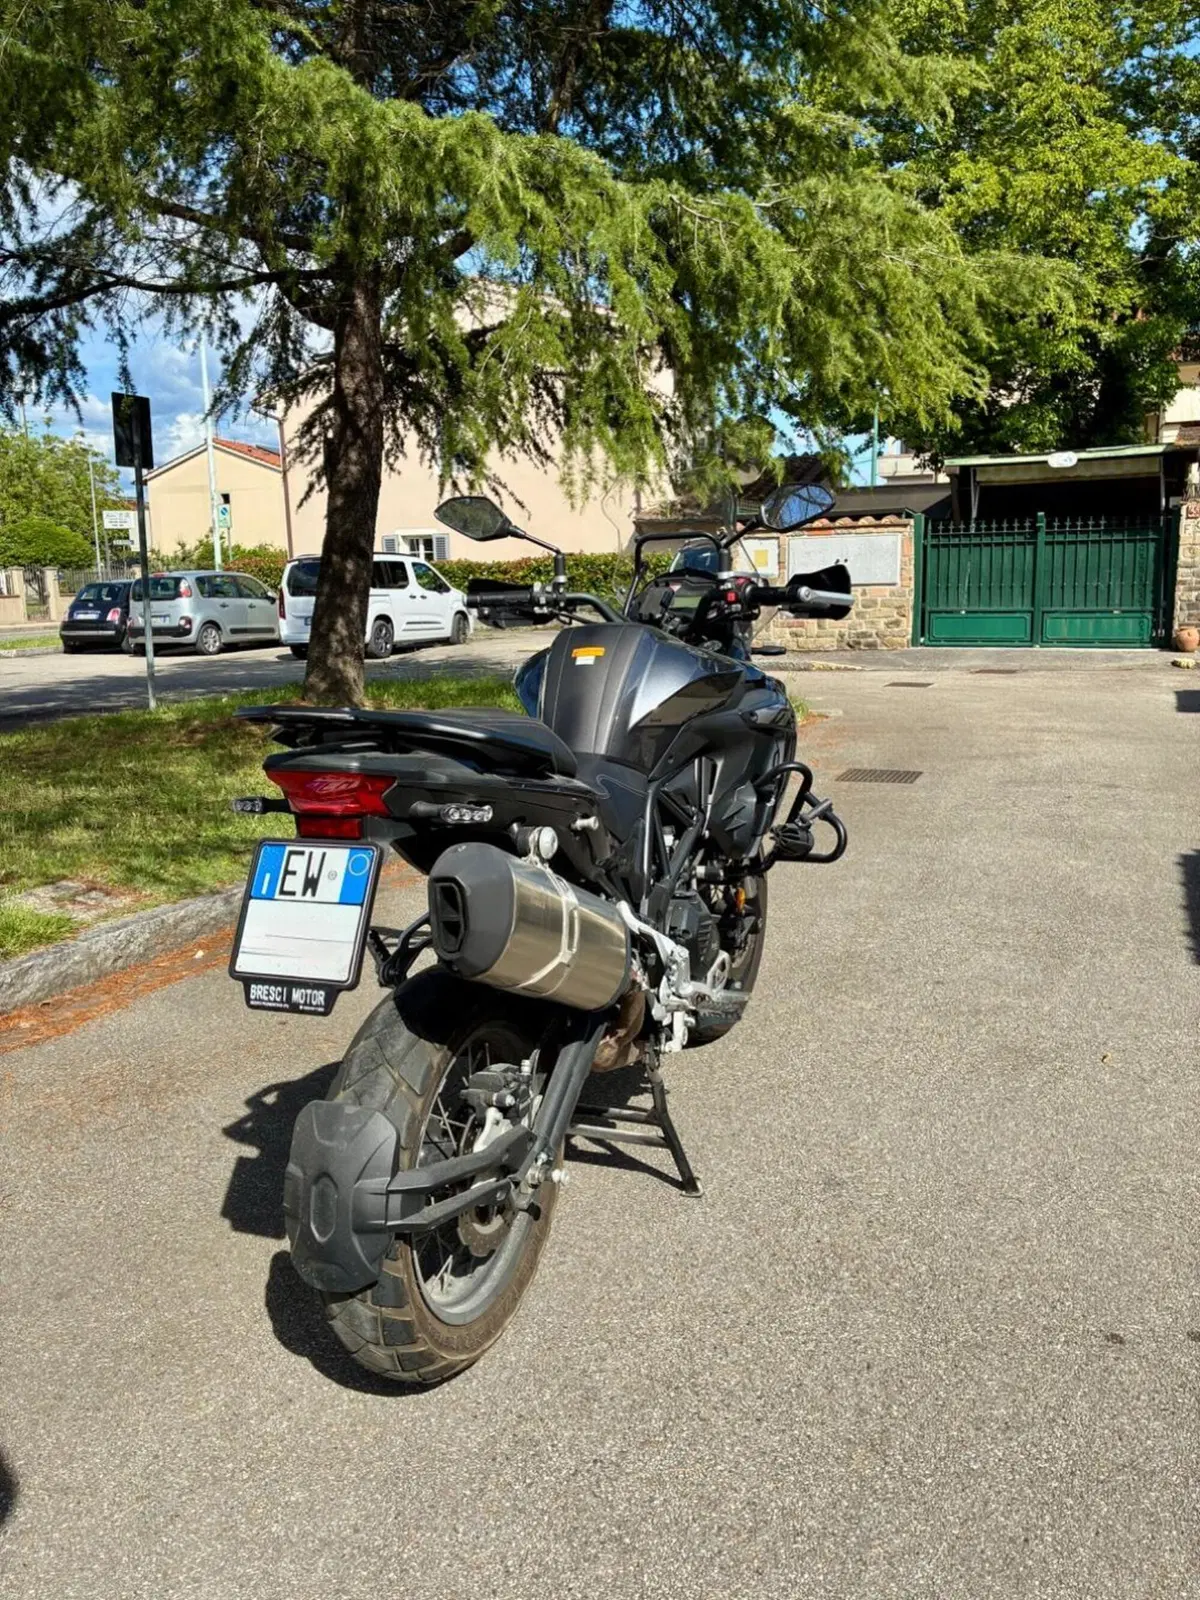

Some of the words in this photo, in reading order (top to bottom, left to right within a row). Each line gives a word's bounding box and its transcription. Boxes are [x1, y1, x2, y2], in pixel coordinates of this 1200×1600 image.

[279, 850, 326, 897] EW
[250, 984, 287, 1002] BRESCI
[292, 987, 325, 1006] MOTOR
